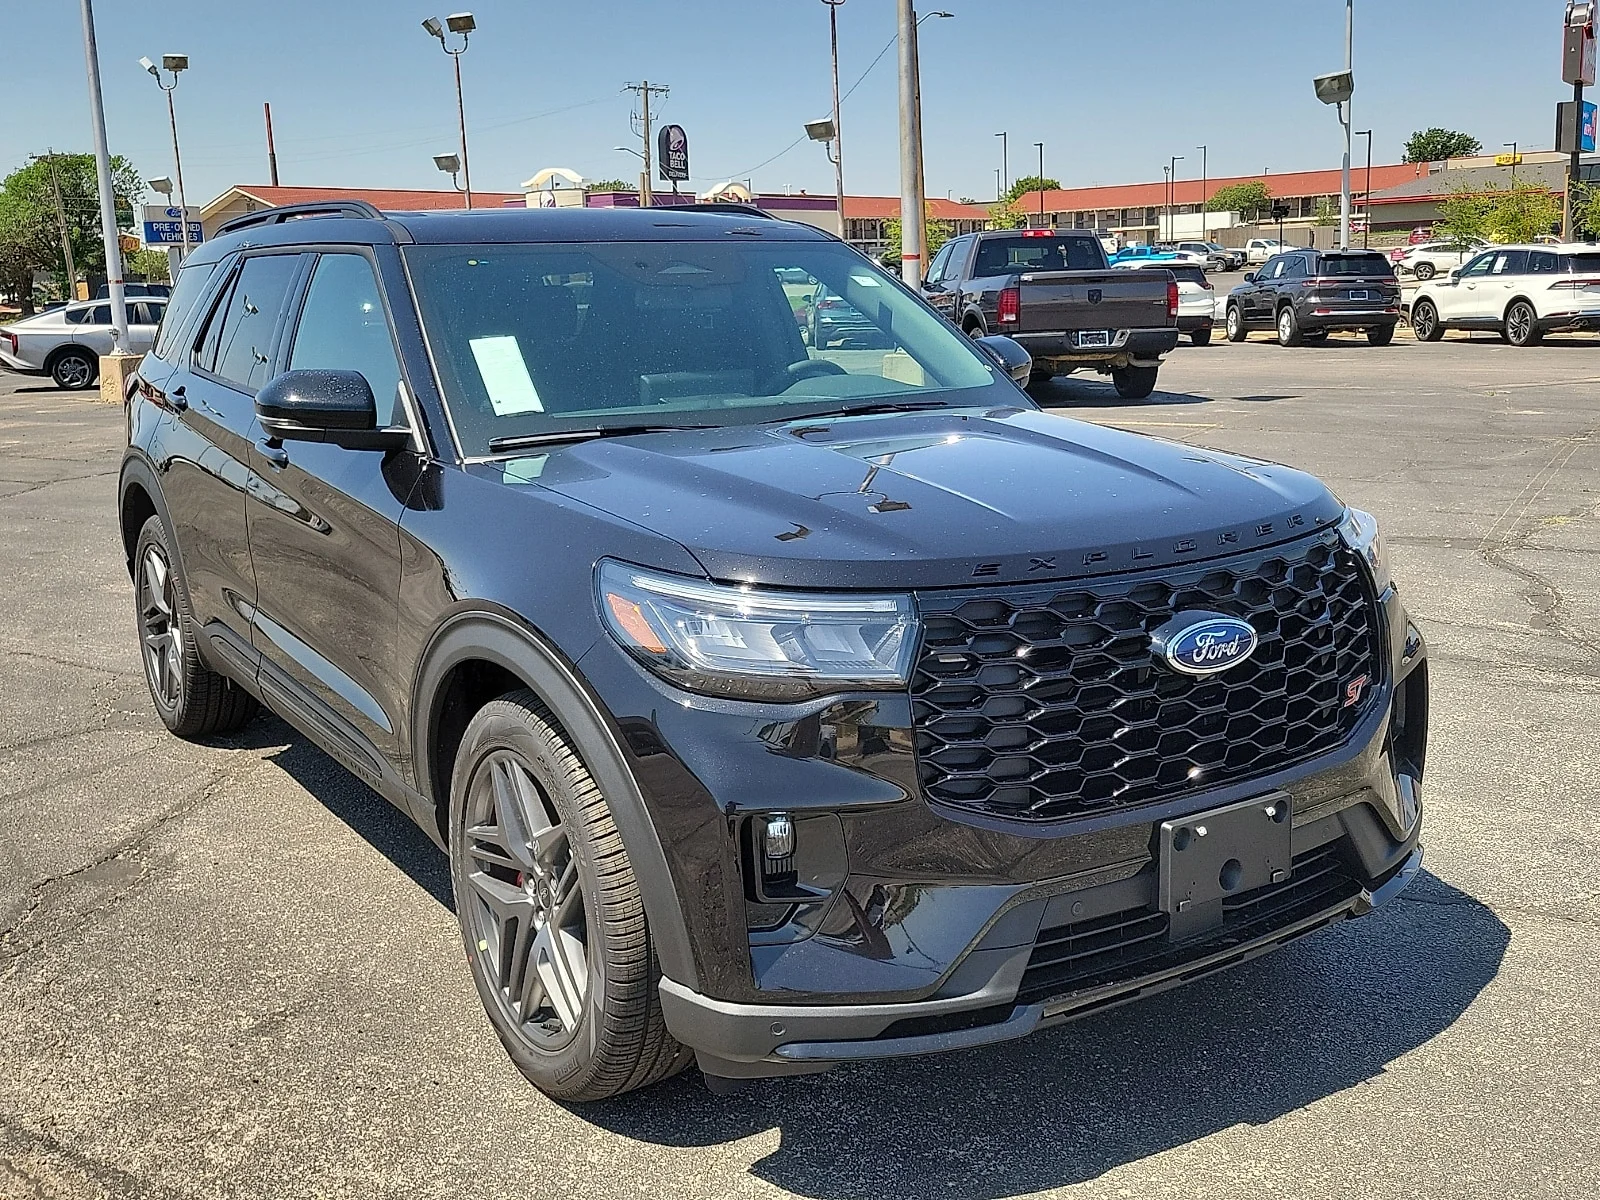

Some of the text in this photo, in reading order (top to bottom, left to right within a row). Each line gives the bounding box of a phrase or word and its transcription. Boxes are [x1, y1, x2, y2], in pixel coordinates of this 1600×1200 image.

[668, 151, 686, 161] TACO
[669, 160, 686, 169] BELL
[152, 222, 201, 232] PRE-ONED
[159, 232, 198, 241] VEHICES
[970, 513, 1306, 577] EXPLORER
[1192, 630, 1241, 663] Ford
[1343, 674, 1367, 708] ST
